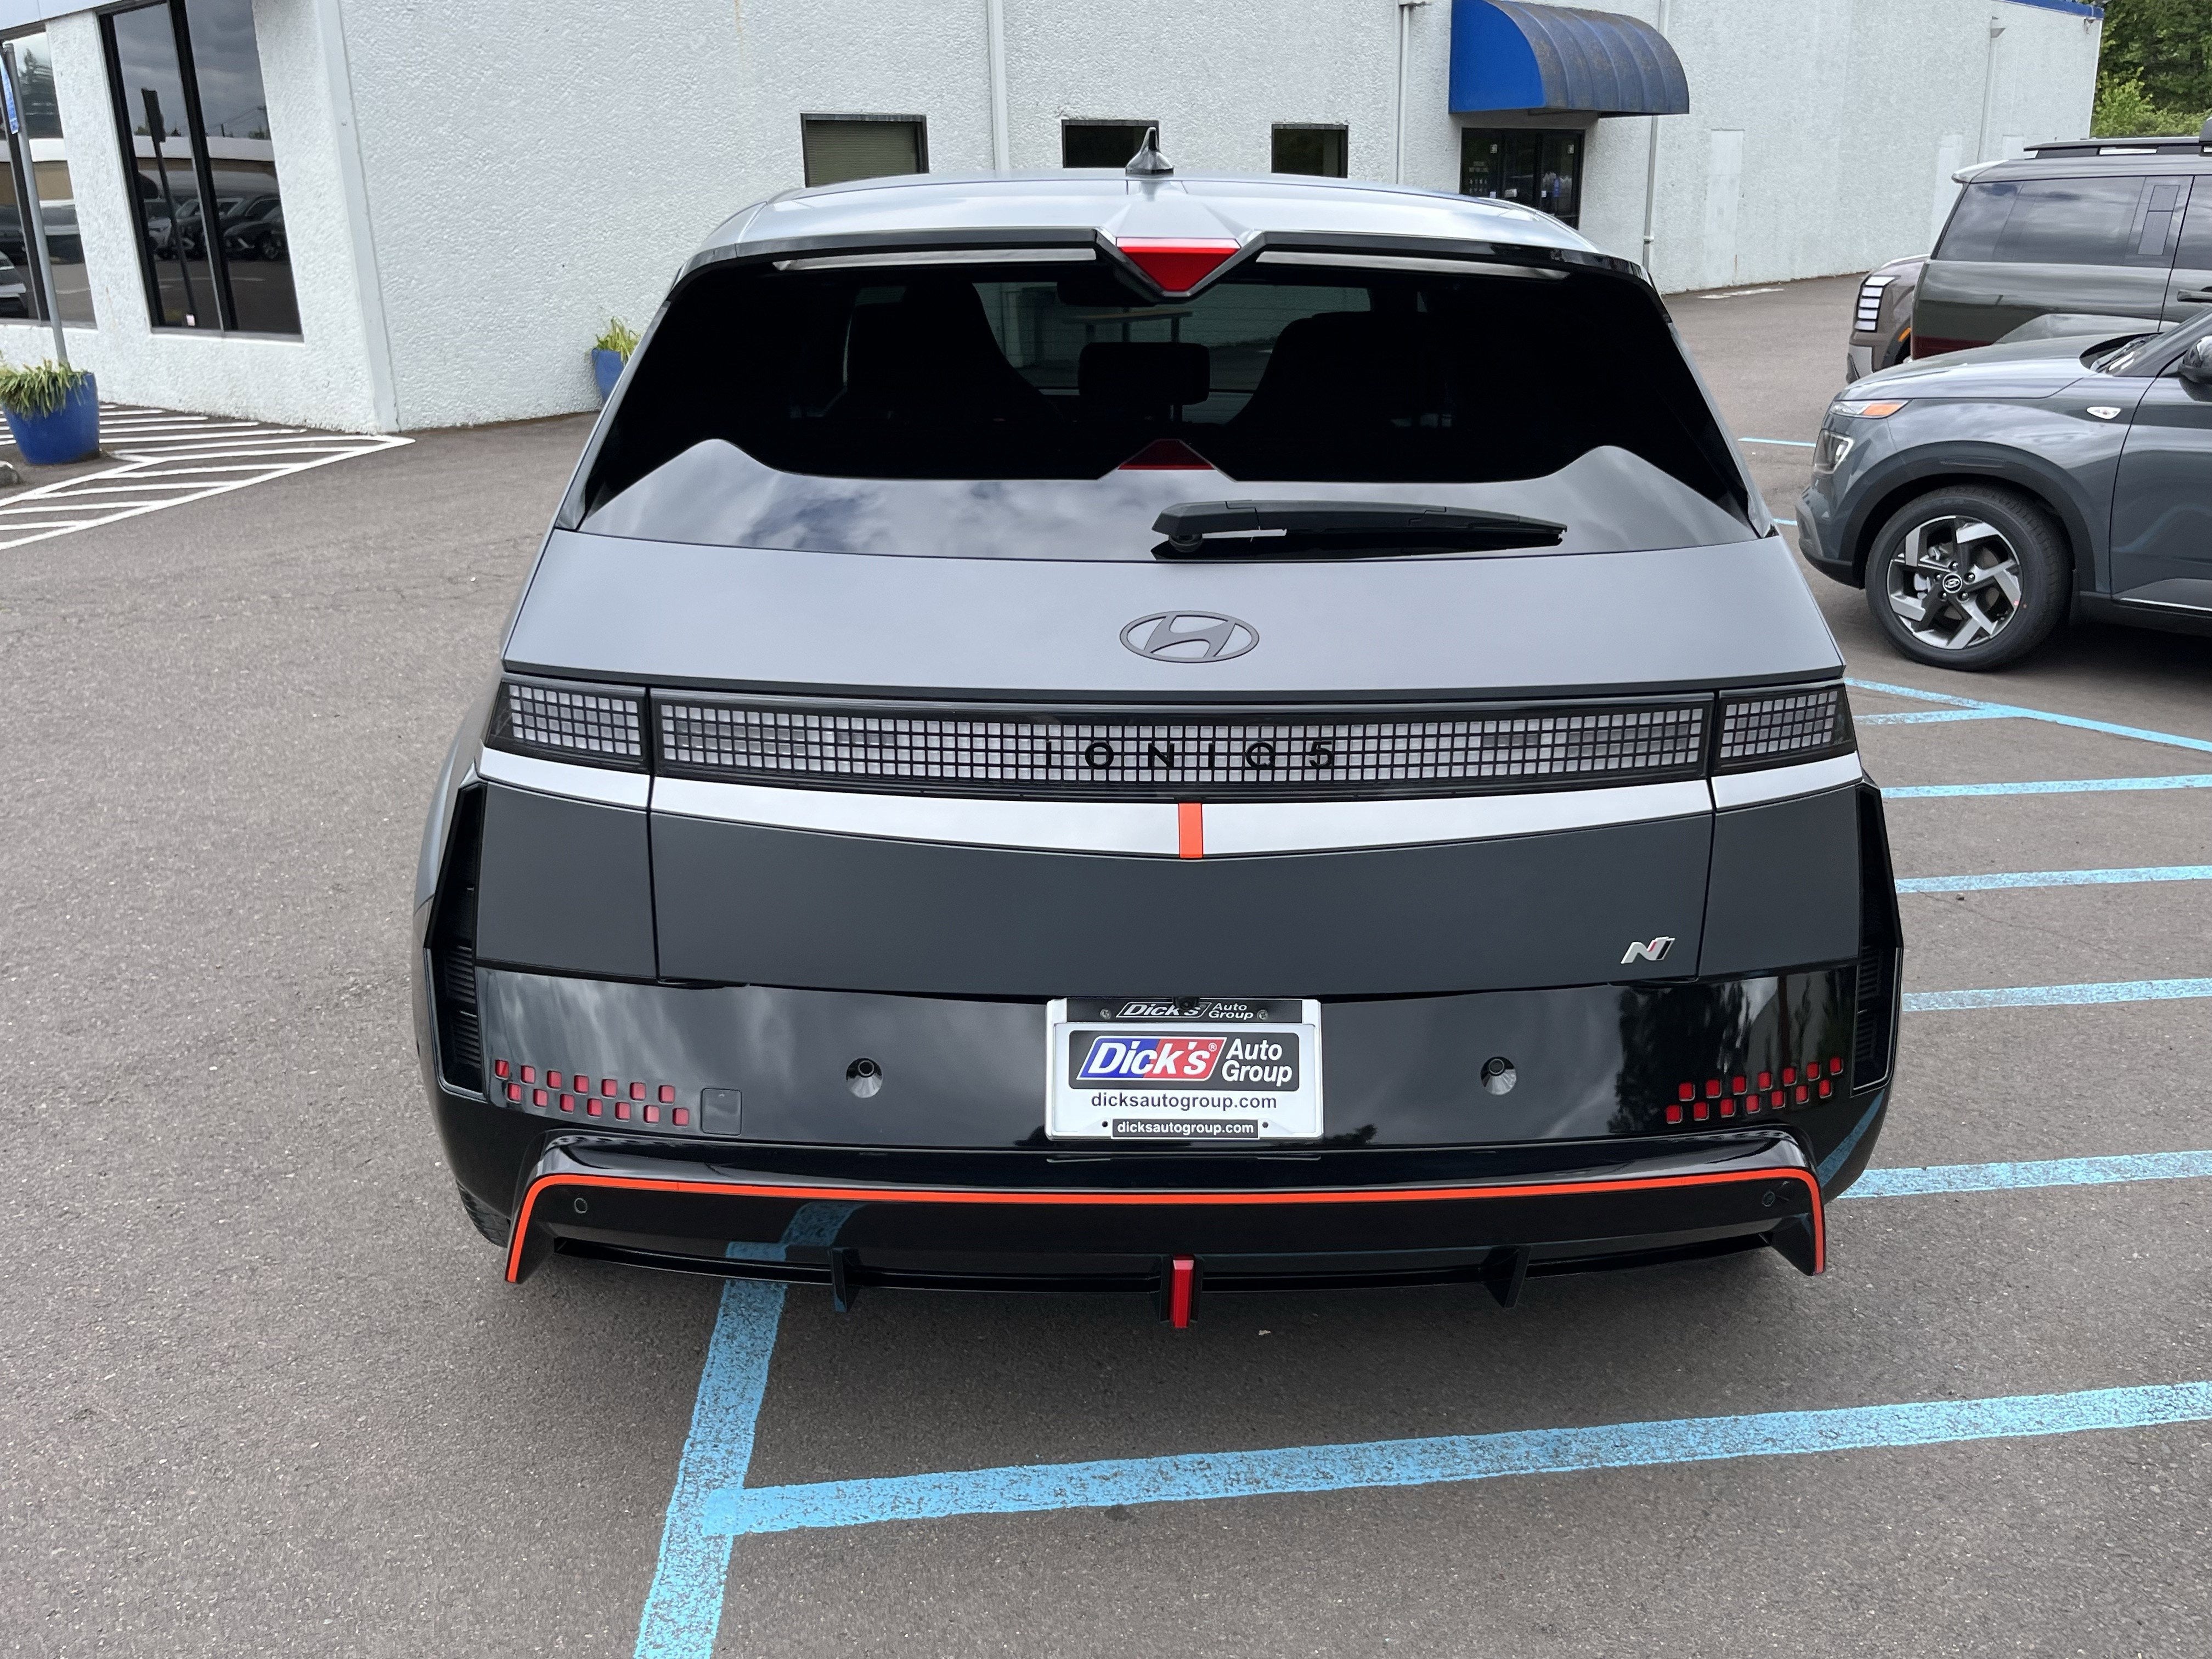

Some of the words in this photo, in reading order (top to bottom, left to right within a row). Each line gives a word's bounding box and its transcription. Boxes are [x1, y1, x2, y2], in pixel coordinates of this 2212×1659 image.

[1045, 740, 1276, 769] IONIQ
[1310, 740, 1333, 768] 5
[1124, 1003, 1201, 1016] Dicks
[1208, 1010, 1254, 1020] Group
[1212, 1003, 1248, 1011] Auto
[1087, 1040, 1210, 1075] Dick's
[1225, 1038, 1283, 1060] Auto
[1221, 1059, 1293, 1087] Group
[1091, 1092, 1277, 1111] dicksautogroup.com
[1117, 1121, 1254, 1135] dicksautogroup.com
